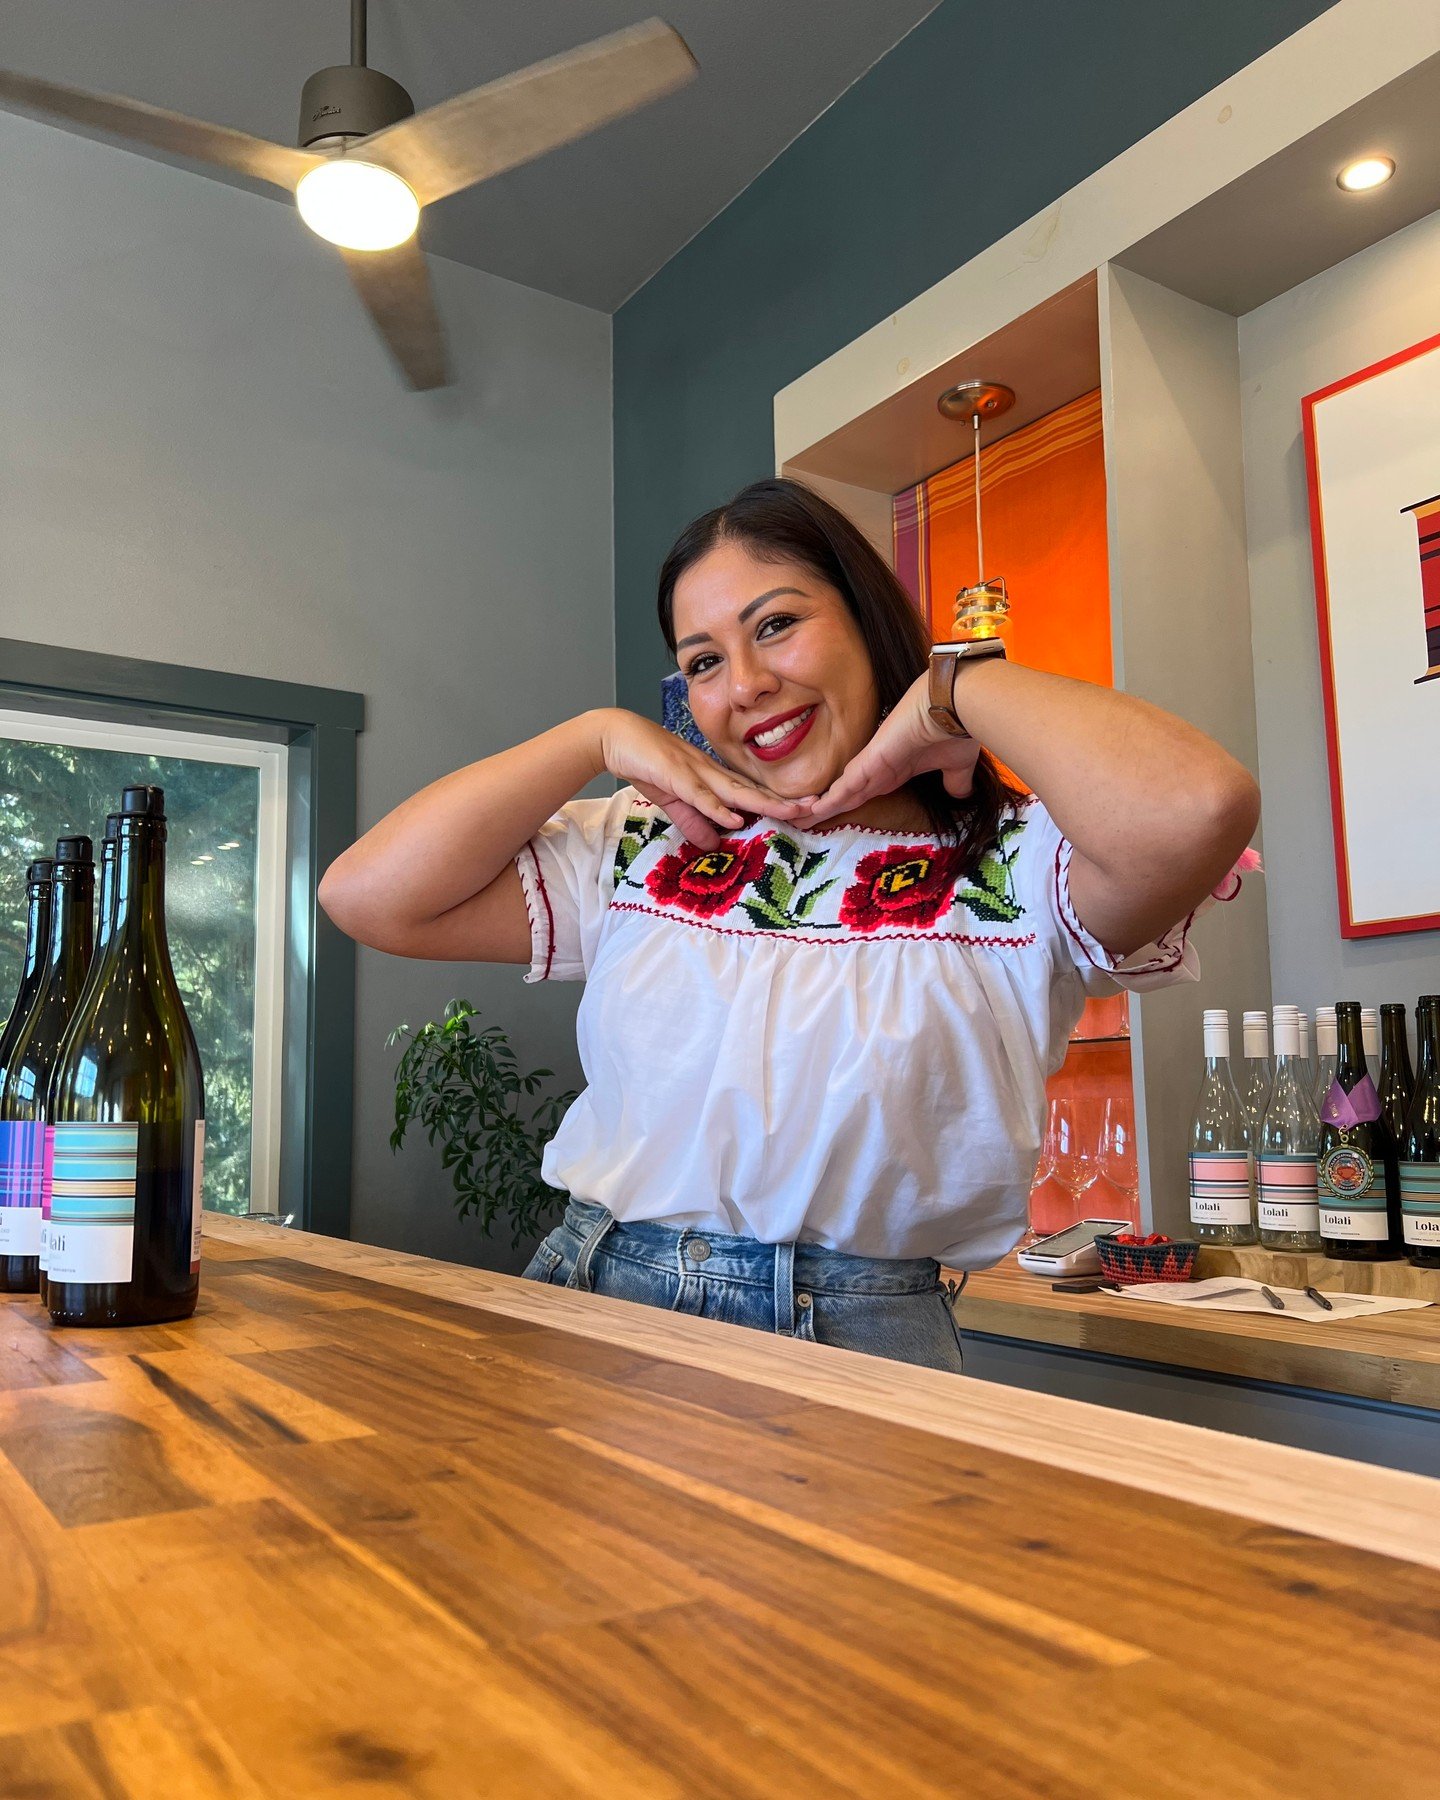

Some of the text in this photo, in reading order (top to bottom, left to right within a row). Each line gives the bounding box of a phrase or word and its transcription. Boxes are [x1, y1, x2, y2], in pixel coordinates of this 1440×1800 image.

[1195, 1201, 1220, 1211] Lolali
[1263, 1207, 1289, 1217] Lolali
[1324, 1214, 1351, 1225] Lolali
